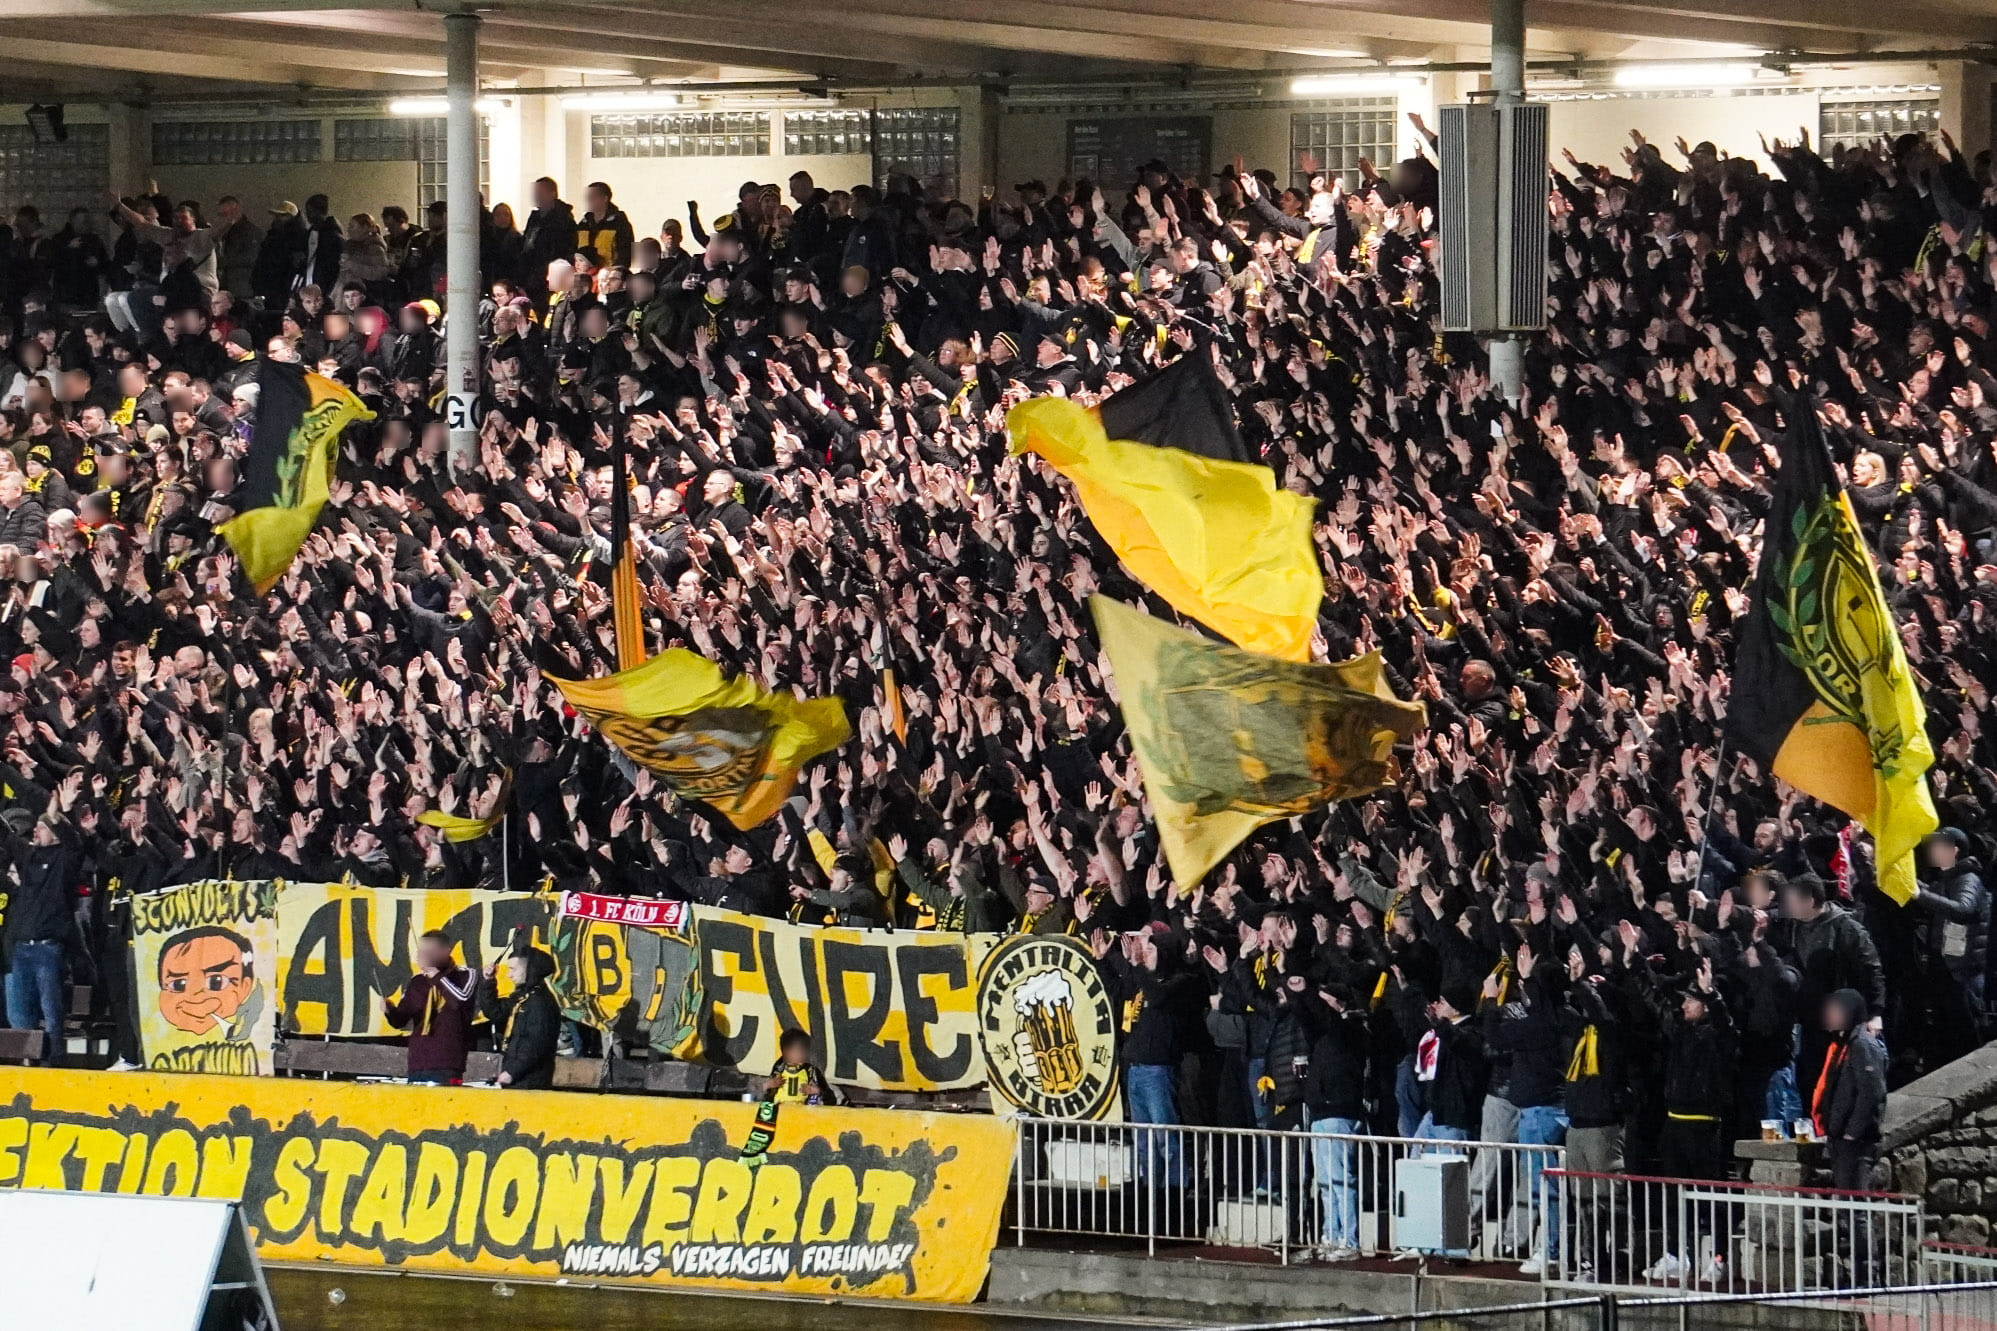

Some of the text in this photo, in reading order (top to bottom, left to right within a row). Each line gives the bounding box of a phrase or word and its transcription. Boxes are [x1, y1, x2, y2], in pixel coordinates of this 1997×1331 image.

[133, 880, 258, 936] SCONVOLTS
[590, 900, 658, 923] 1. FC KÖLN
[1008, 1069, 1102, 1118] BIRRA
[263, 1136, 918, 1251] STADIONVERBOT
[563, 1243, 916, 1277] NIEMALS VERZAGEN FREUNDE!
